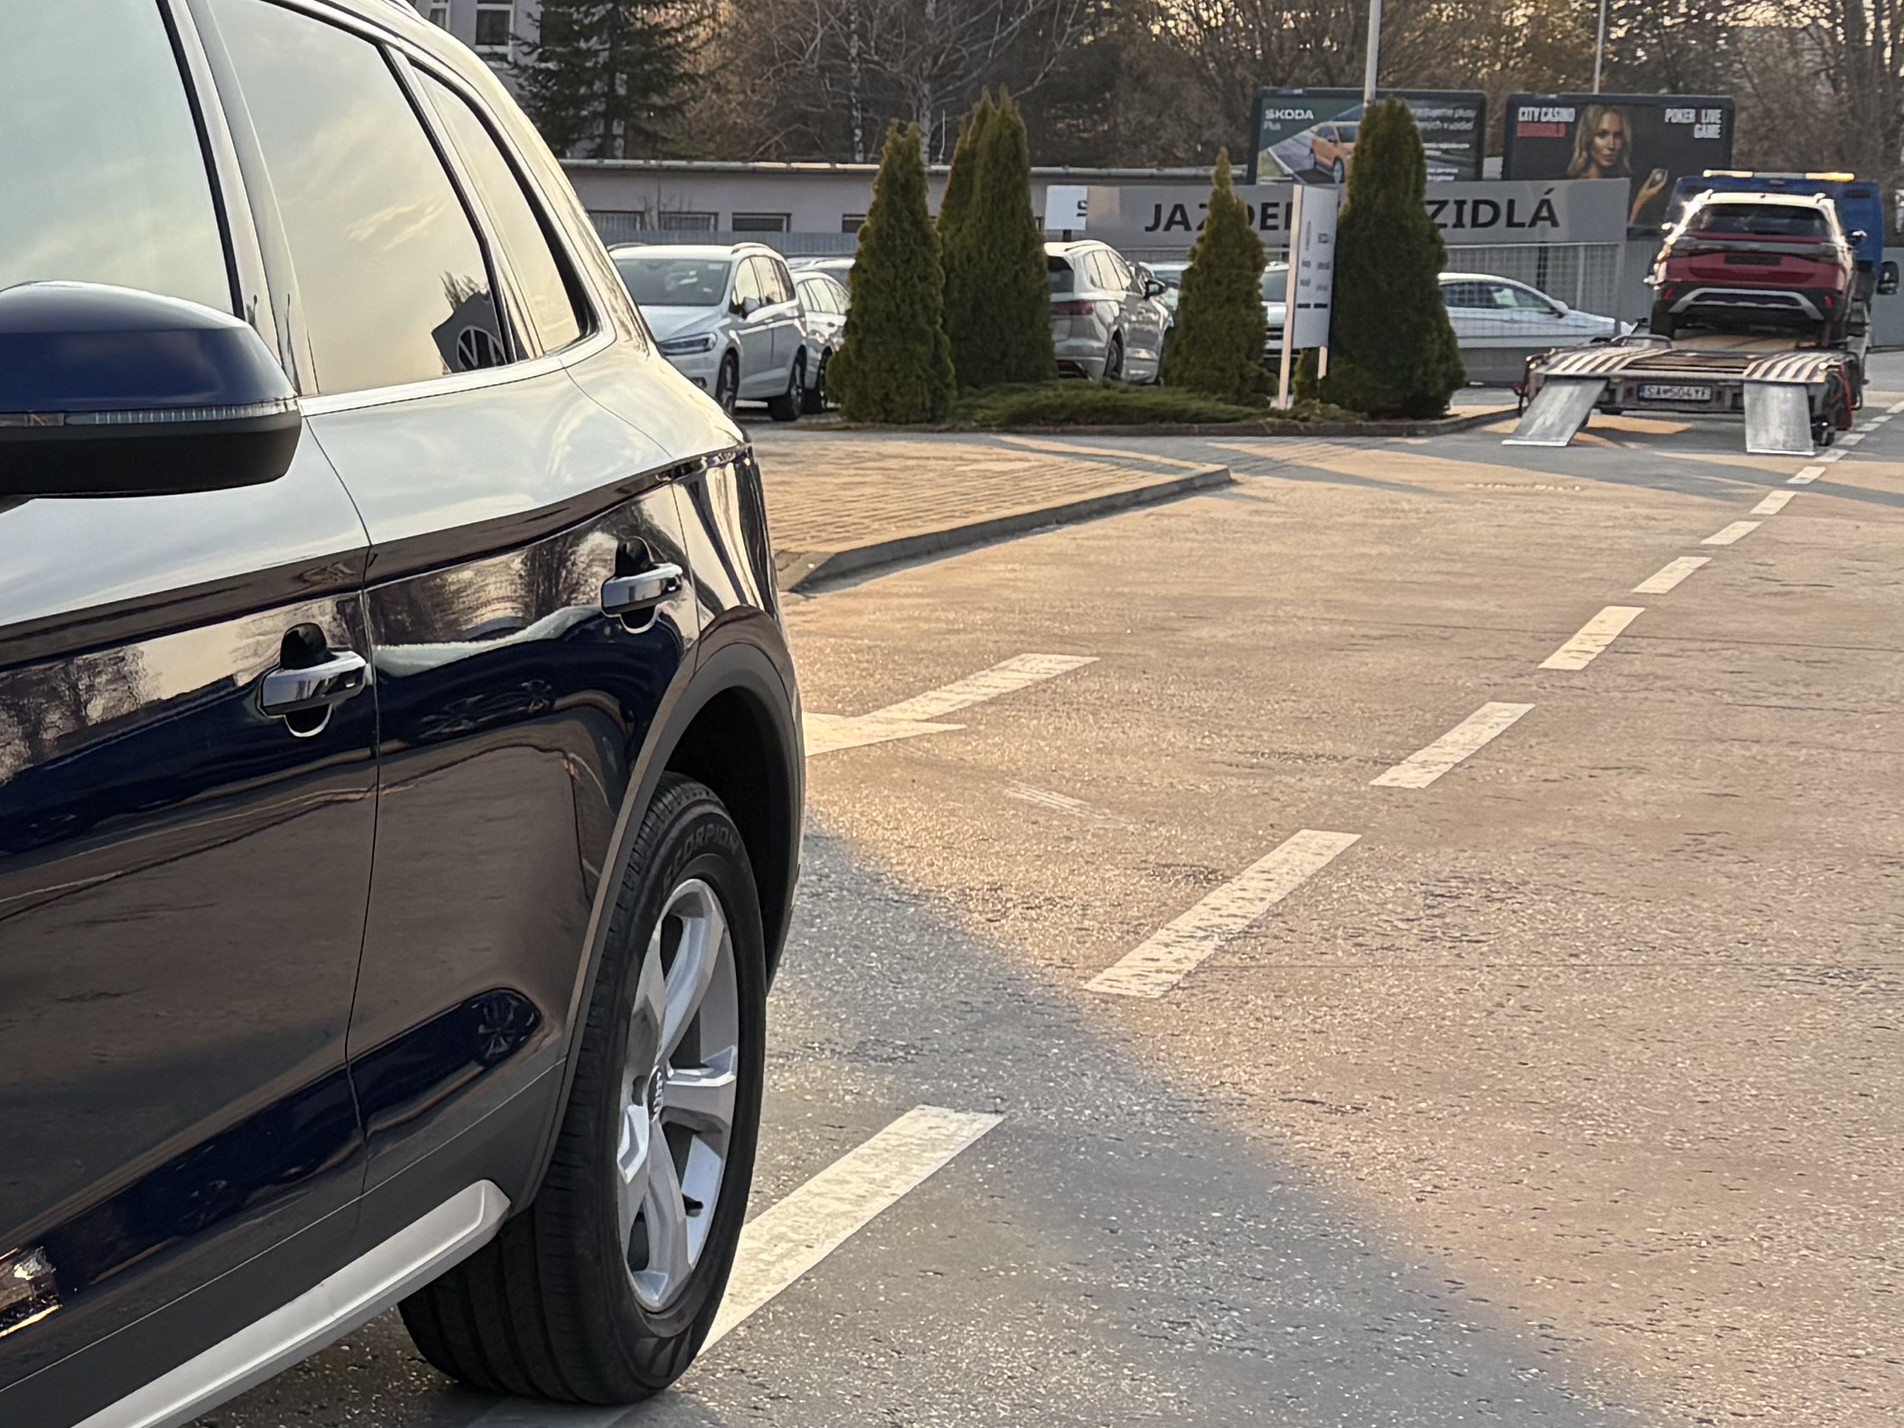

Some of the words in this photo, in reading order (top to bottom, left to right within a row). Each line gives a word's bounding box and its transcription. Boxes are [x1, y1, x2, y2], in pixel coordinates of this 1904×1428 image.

[1518, 106, 1540, 122] CITY
[1665, 108, 1696, 124] POKER
[1701, 109, 1722, 124] LIVE
